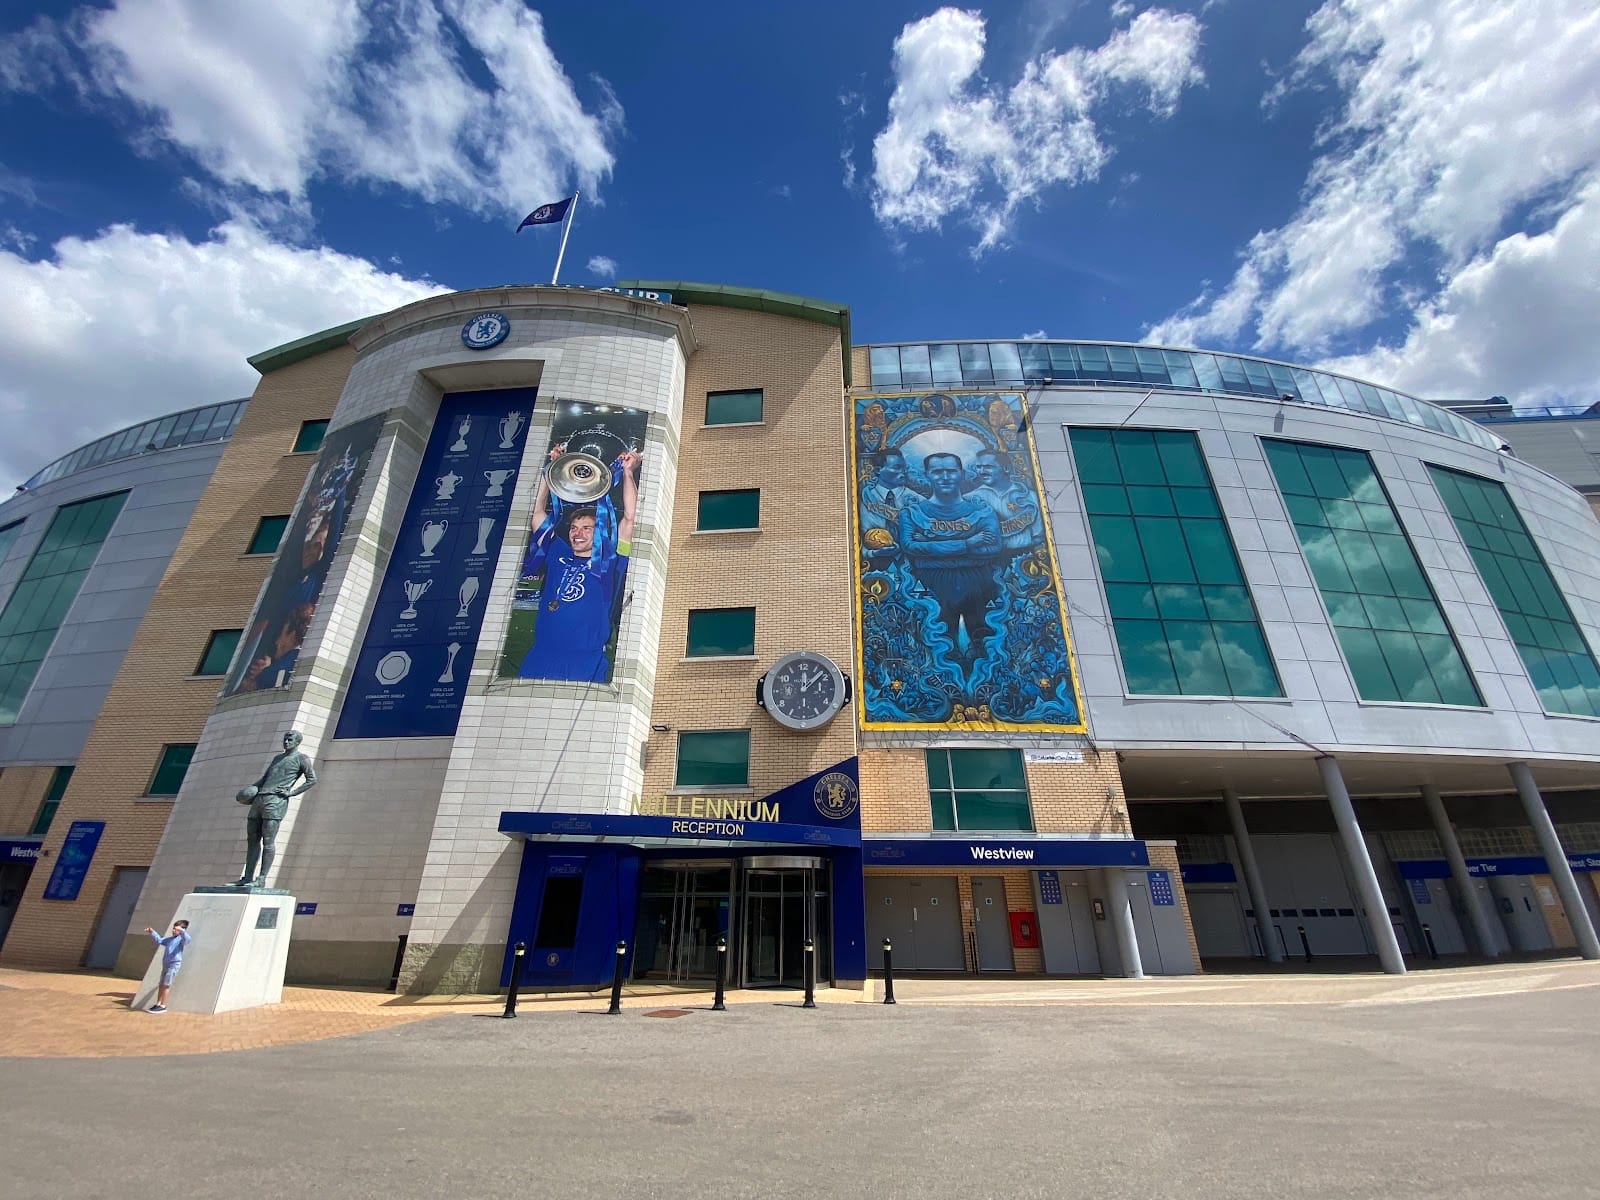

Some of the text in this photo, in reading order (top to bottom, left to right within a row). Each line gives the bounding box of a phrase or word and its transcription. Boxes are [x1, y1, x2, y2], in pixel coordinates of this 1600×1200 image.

[930, 519, 971, 532] JONES
[798, 663, 809, 671] 12
[780, 674, 790, 683] 10
[779, 699, 786, 707] 8
[822, 697, 829, 705] 4
[821, 774, 849, 786] CHELSEA
[630, 793, 780, 822] MILLENNIUM
[671, 821, 744, 836] RECEPTION
[10, 846, 40, 859] Westvi
[970, 846, 1034, 860] Westview
